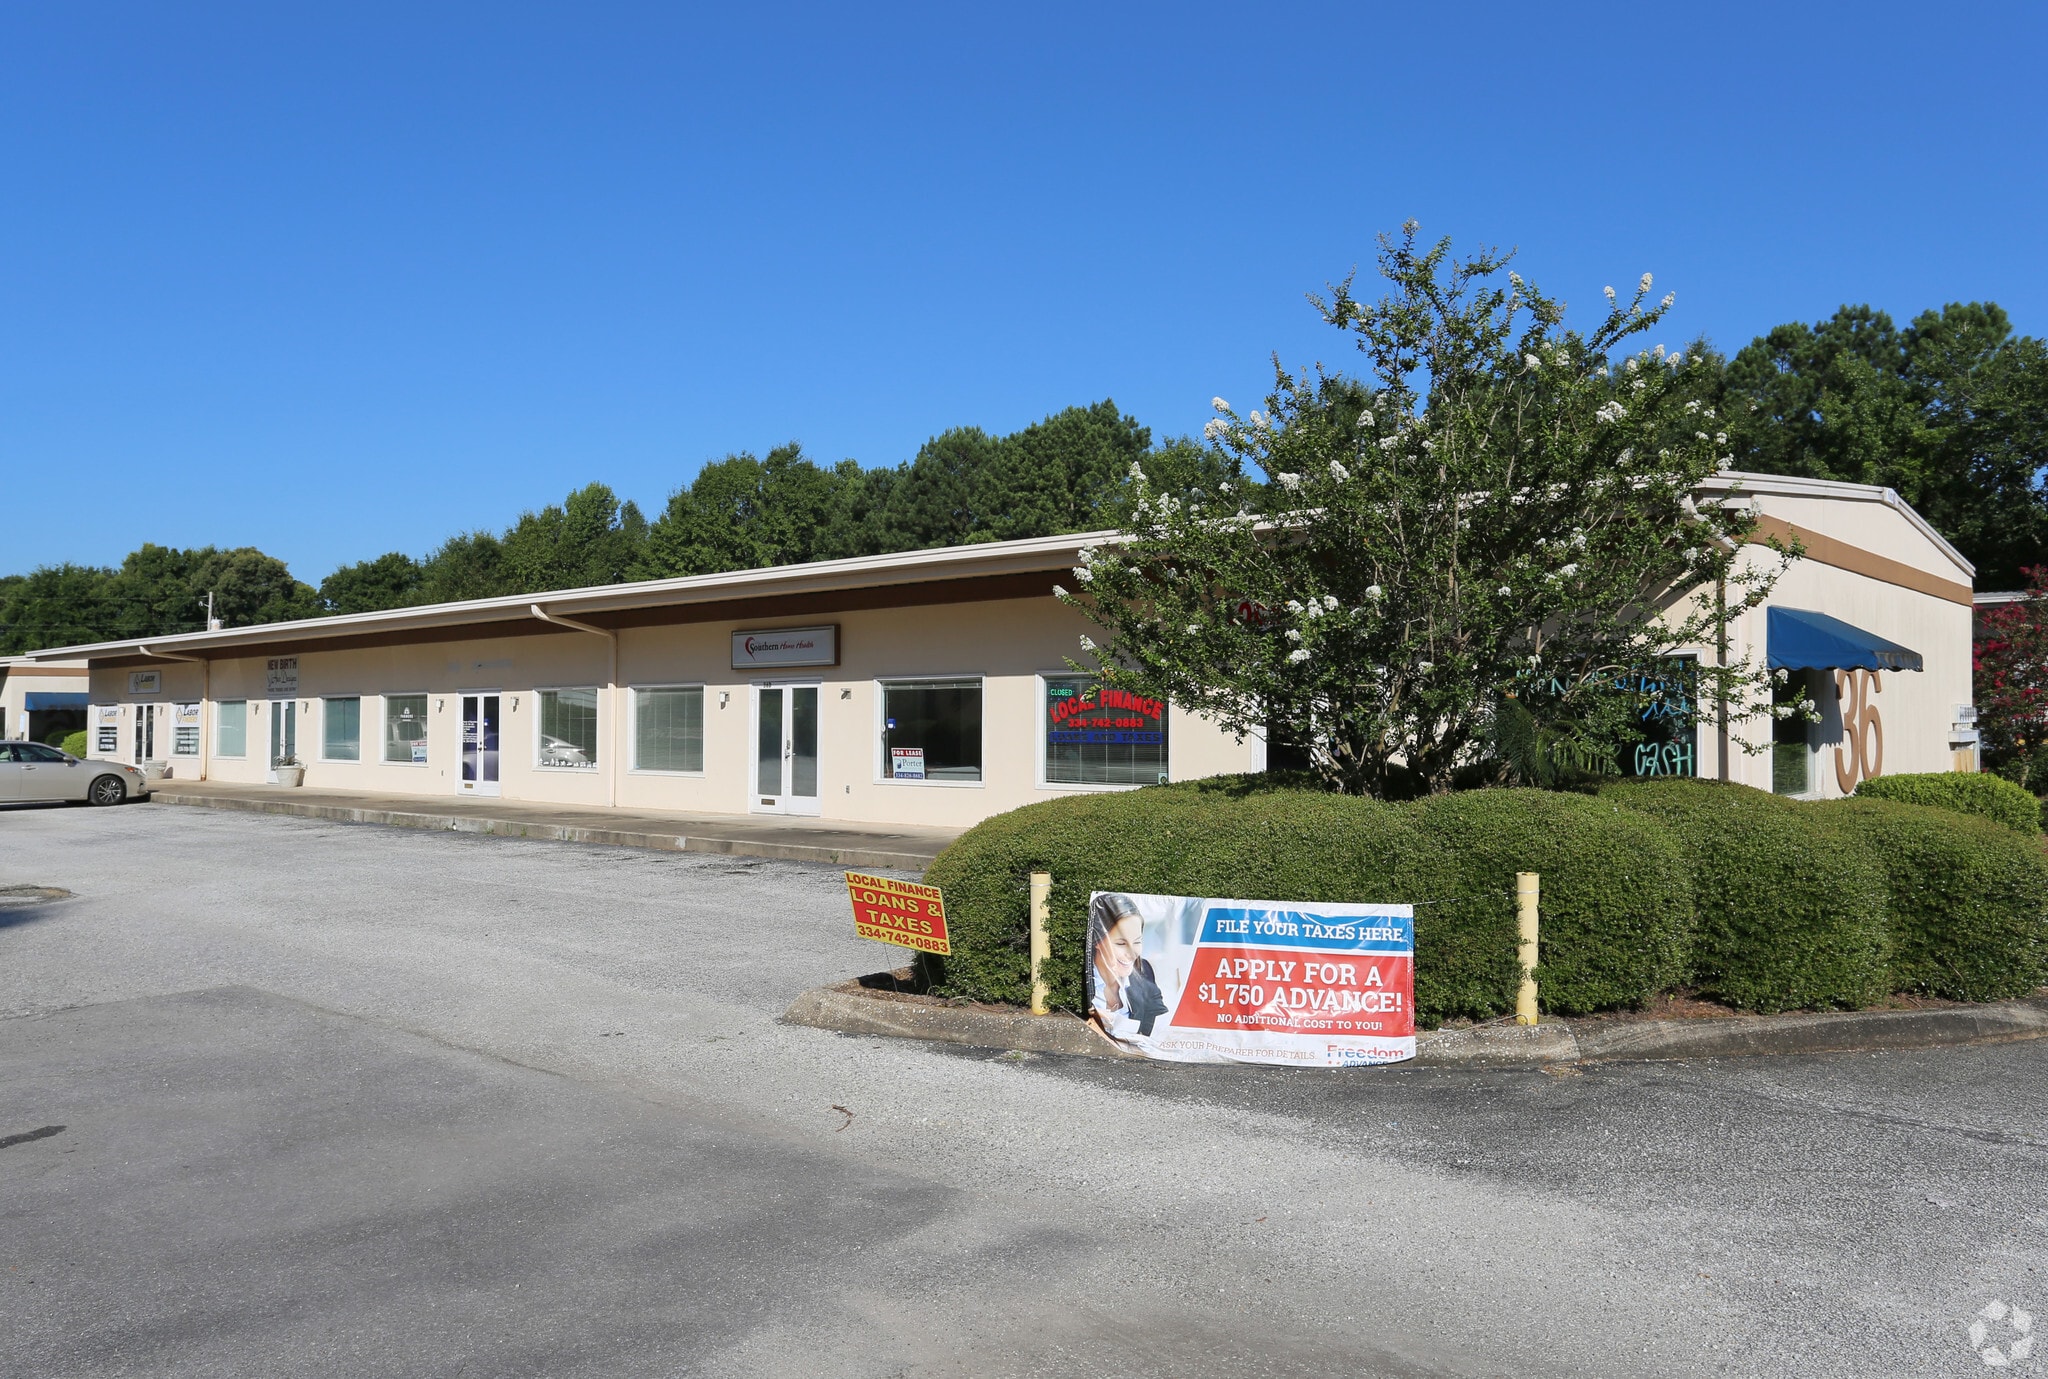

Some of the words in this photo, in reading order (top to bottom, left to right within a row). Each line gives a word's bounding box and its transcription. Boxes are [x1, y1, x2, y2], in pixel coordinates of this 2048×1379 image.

[750, 641, 779, 653] Southern
[280, 658, 297, 670] BIRTH
[1050, 688, 1073, 696] CLOSED
[183, 706, 199, 717] LABOR
[1100, 690, 1164, 720] FINANCE
[1068, 718, 1144, 728] 334-742-0883
[1834, 669, 1883, 794] 36
[1122, 733, 1160, 742] TAXES
[902, 758, 923, 767] Porter
[846, 873, 885, 889] LOCAL
[887, 880, 940, 899] FINANCE
[851, 888, 920, 913] LOANS
[927, 903, 942, 918] &
[866, 909, 933, 934] TAXES
[1216, 920, 1249, 934] FILE
[1253, 921, 1298, 937] YOUR
[1302, 924, 1355, 940] TAXES
[1359, 927, 1403, 942] HERE
[1215, 958, 1295, 982] APPLY
[1304, 962, 1358, 985] FOR
[1366, 966, 1383, 987] A
[1198, 981, 1265, 1008] $1,750
[1273, 987, 1403, 1013] ADVANCE!
[1217, 1013, 1232, 1023] NO
[1234, 1014, 1301, 1028] ADDITIONAL
[1303, 1018, 1334, 1030] COST
[1336, 1020, 1351, 1030] TO
[1354, 1020, 1383, 1031] YOU!
[1159, 1040, 1178, 1049] ASK
[1178, 1041, 1205, 1049] YOUR
[1205, 1042, 1255, 1057] PREPARER
[1255, 1048, 1275, 1057] FOR
[1327, 1044, 1404, 1059] Freedom
